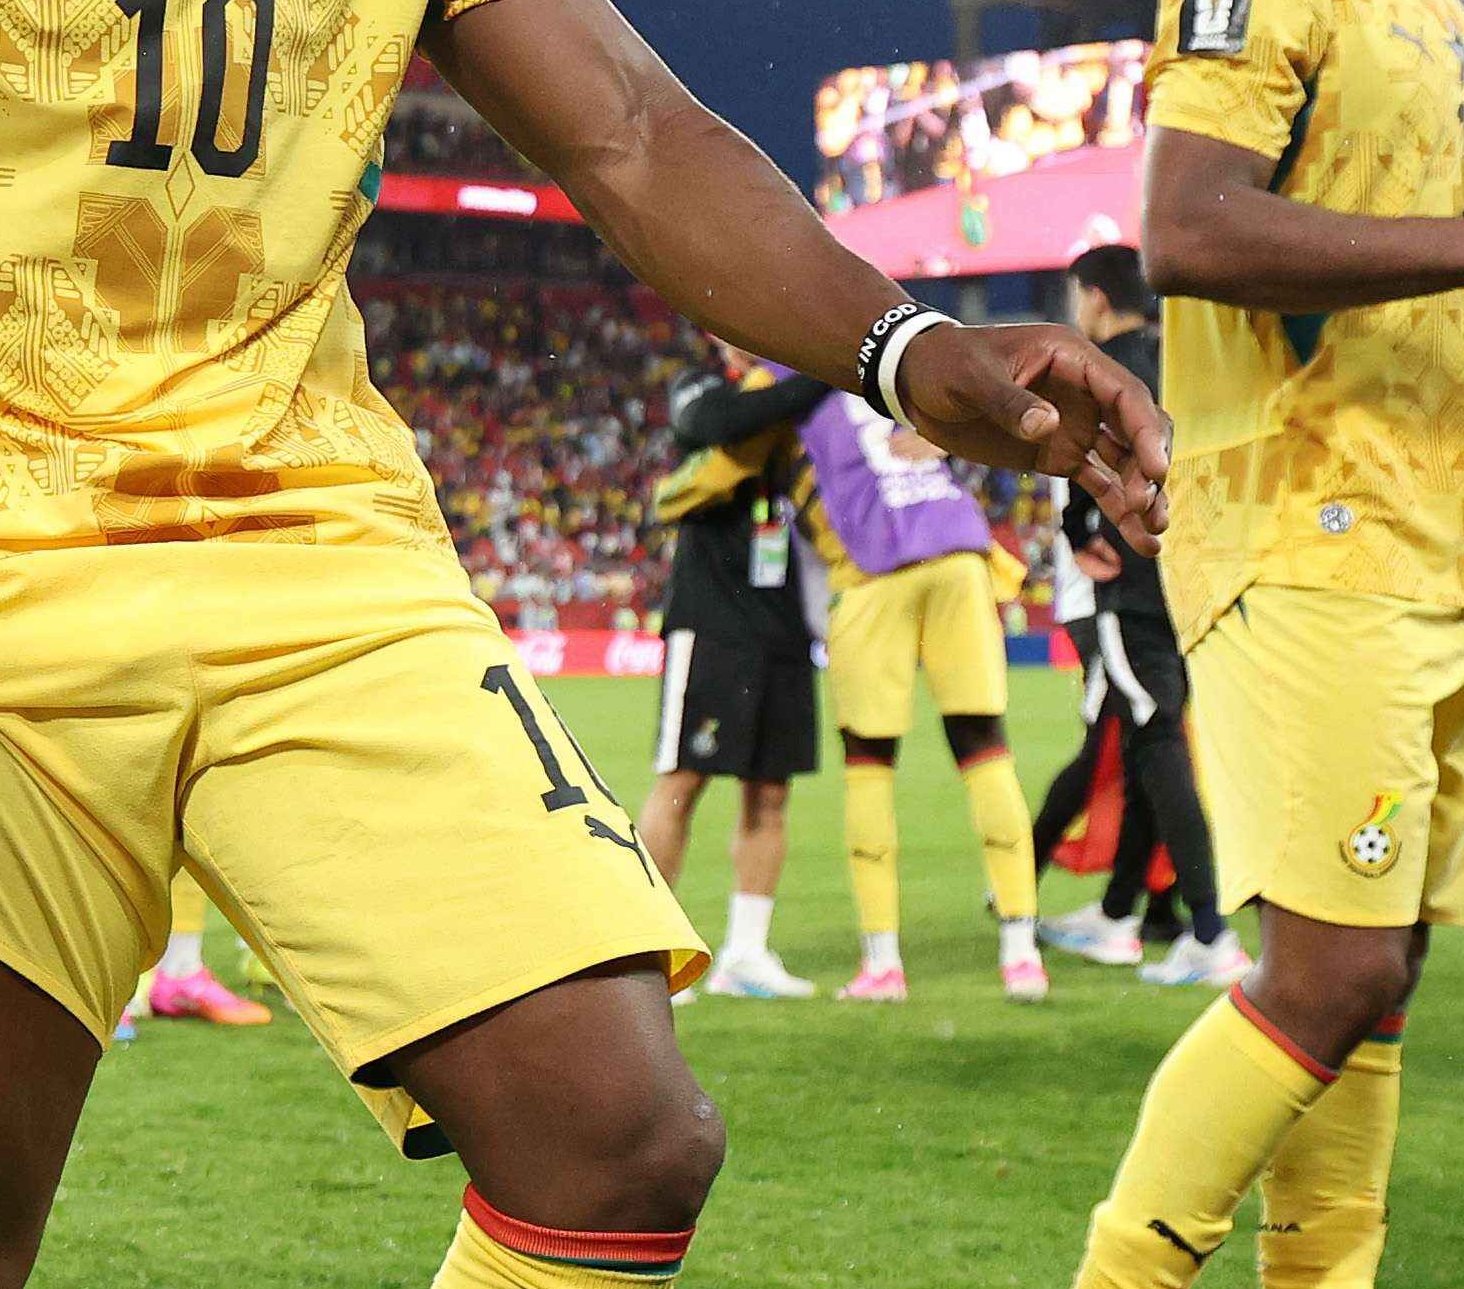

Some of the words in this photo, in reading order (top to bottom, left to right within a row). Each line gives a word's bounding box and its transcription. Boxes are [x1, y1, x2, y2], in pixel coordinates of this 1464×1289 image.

[858, 337, 877, 363] IN
[873, 303, 918, 336] GOD
[480, 664, 621, 812] 1
